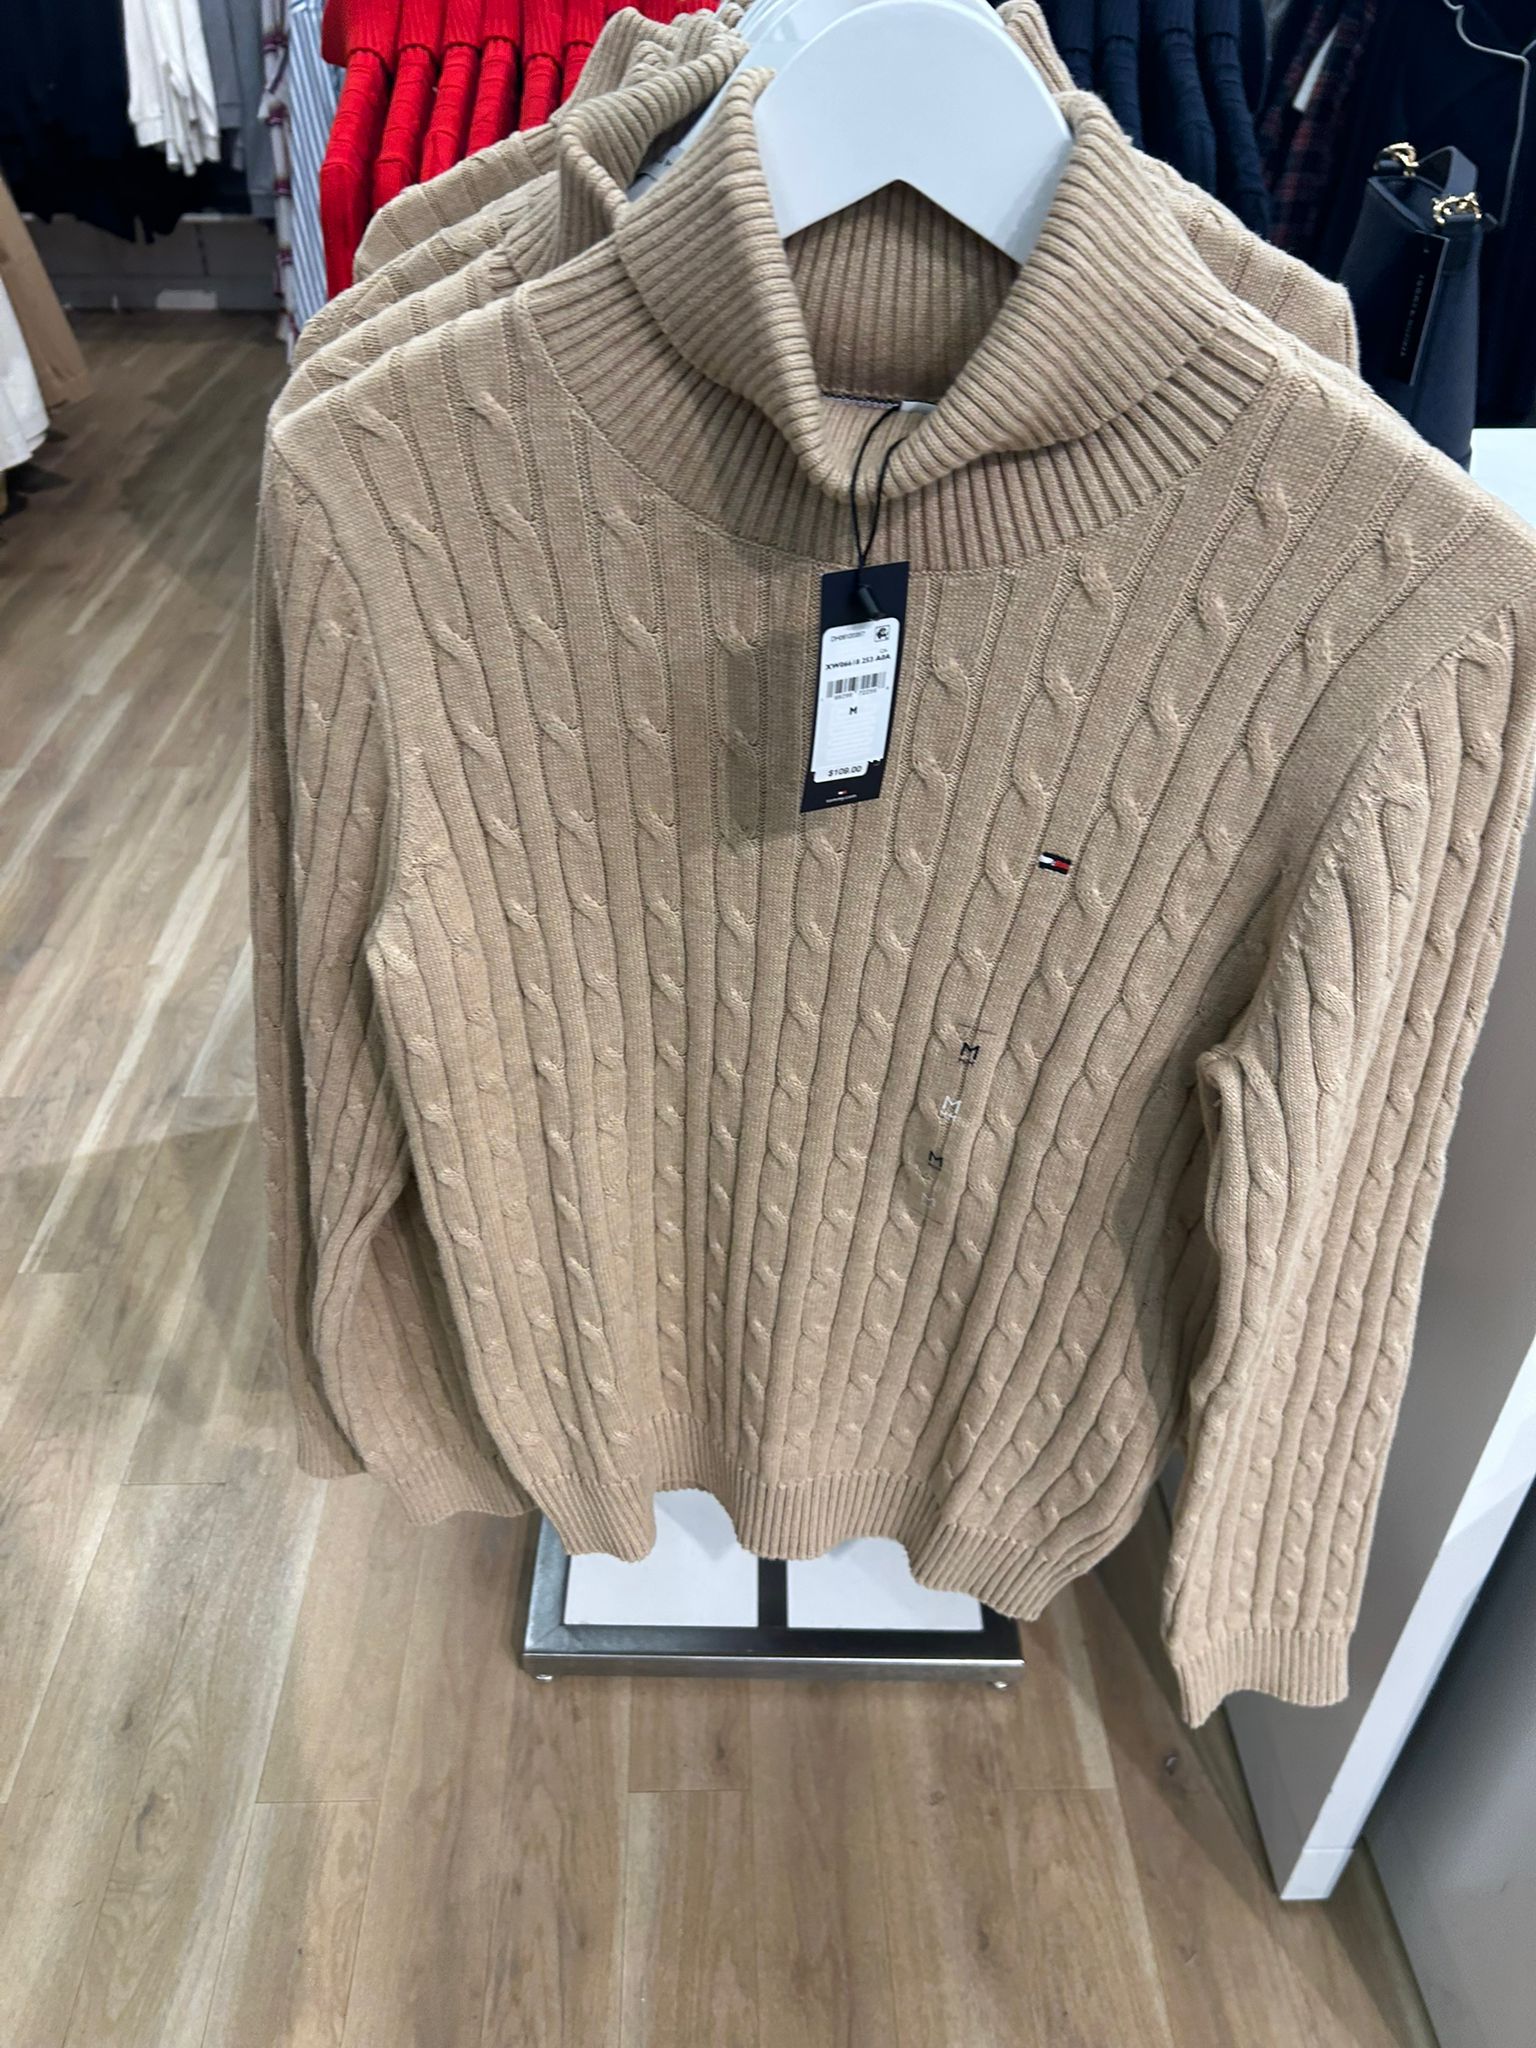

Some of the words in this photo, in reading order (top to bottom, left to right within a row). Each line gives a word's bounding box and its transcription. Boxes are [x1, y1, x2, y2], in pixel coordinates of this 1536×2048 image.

[849, 706, 858, 715] M
[828, 765, 863, 777] $109.00
[960, 1042, 980, 1060] M
[942, 1096, 962, 1114] M
[929, 1151, 943, 1167] M
